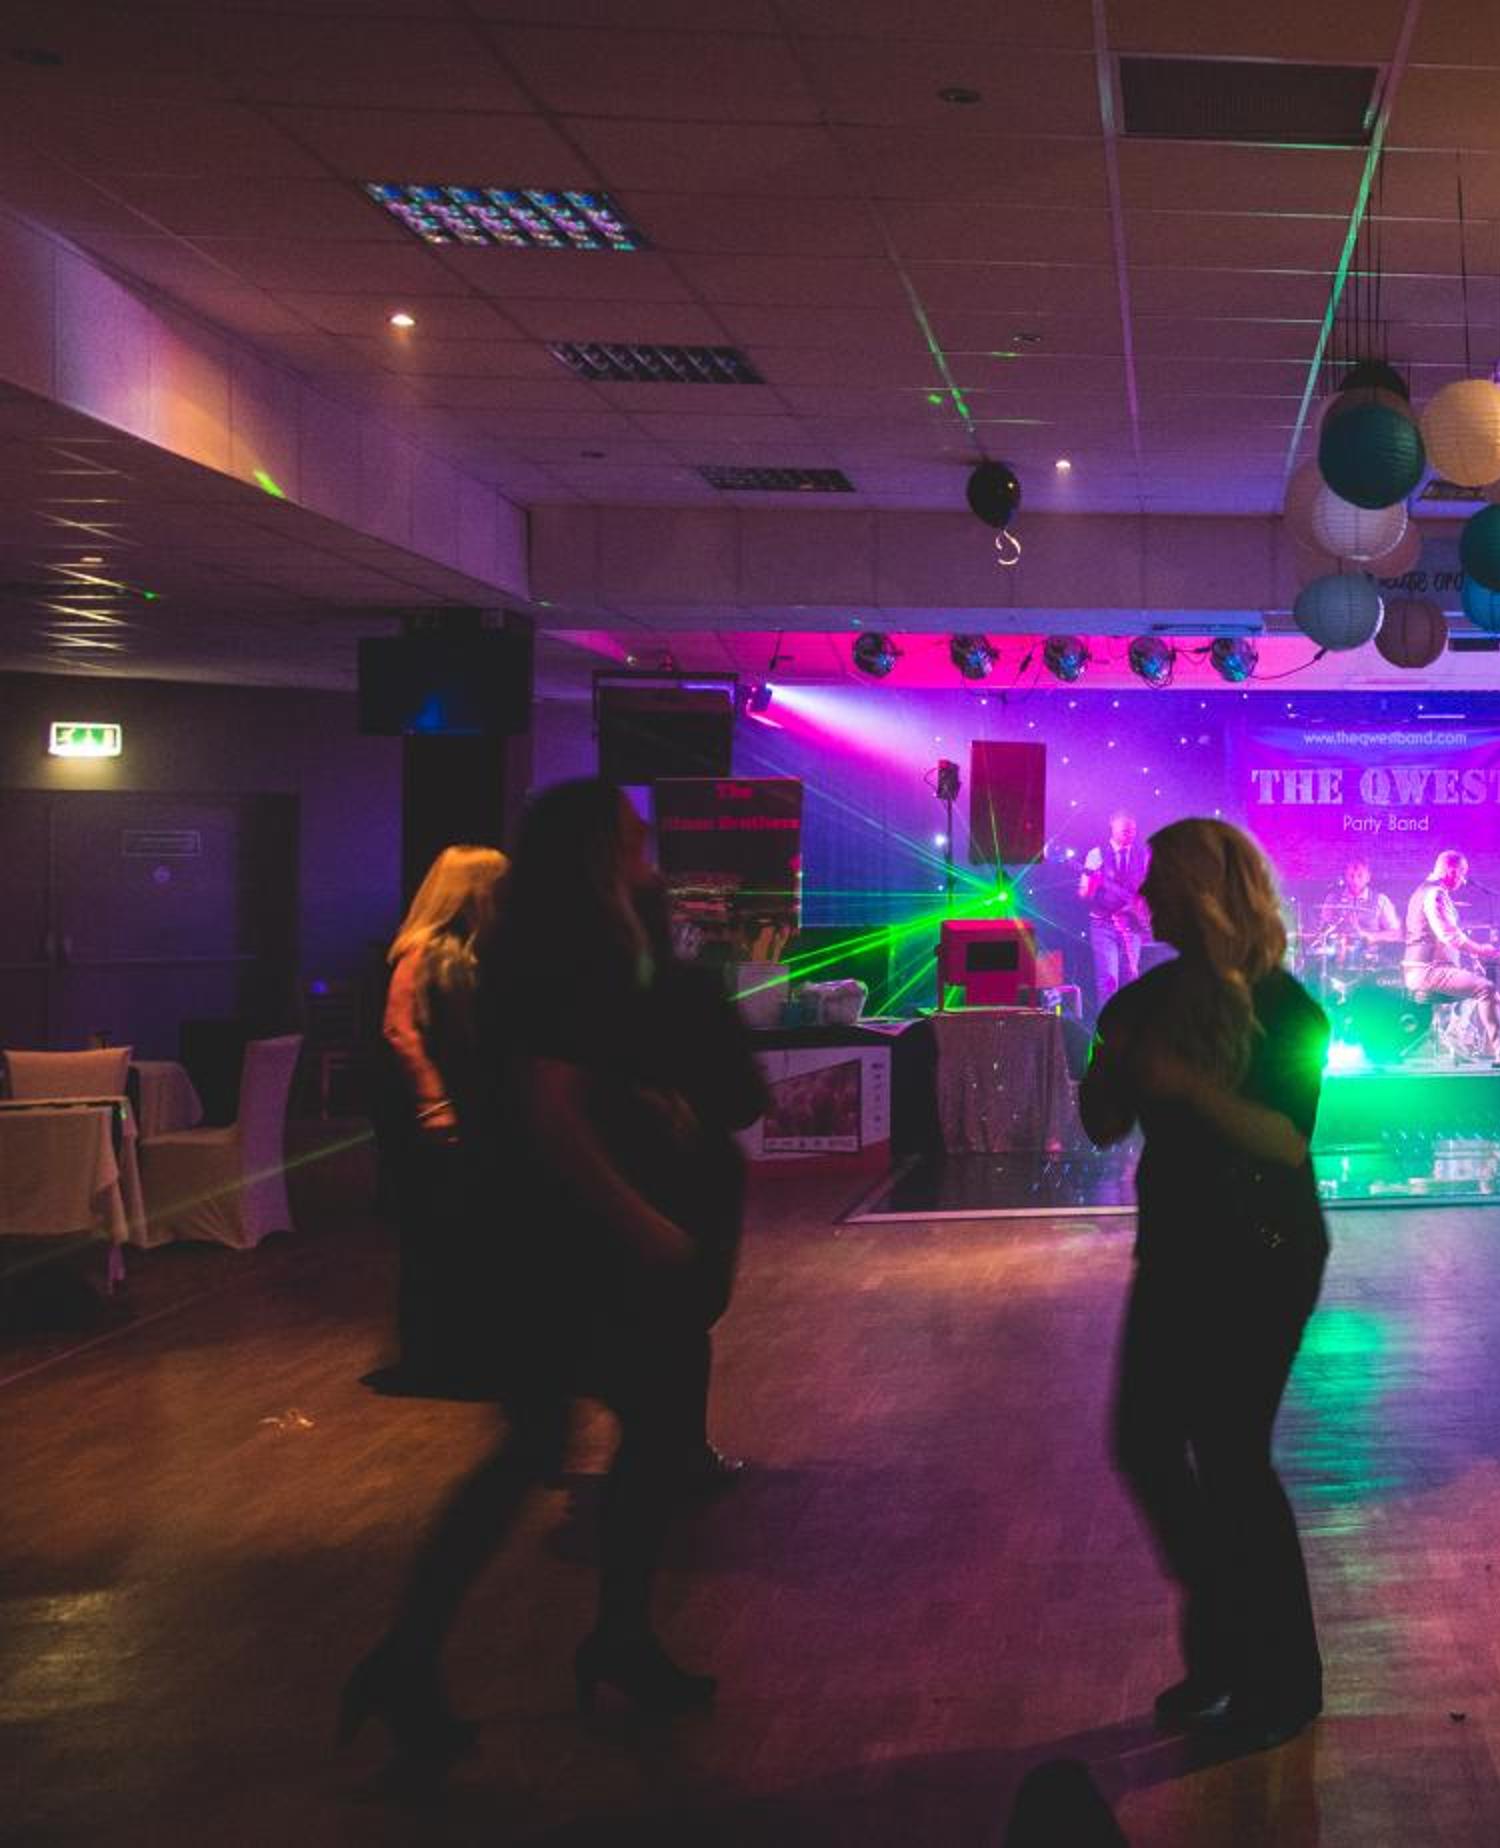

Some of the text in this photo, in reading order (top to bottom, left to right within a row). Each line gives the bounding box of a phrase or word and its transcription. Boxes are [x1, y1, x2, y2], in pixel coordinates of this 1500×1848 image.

[1304, 730, 1467, 747] www.theqwestband.com
[1251, 768, 1344, 805] THE
[1343, 814, 1430, 833] Party Band
